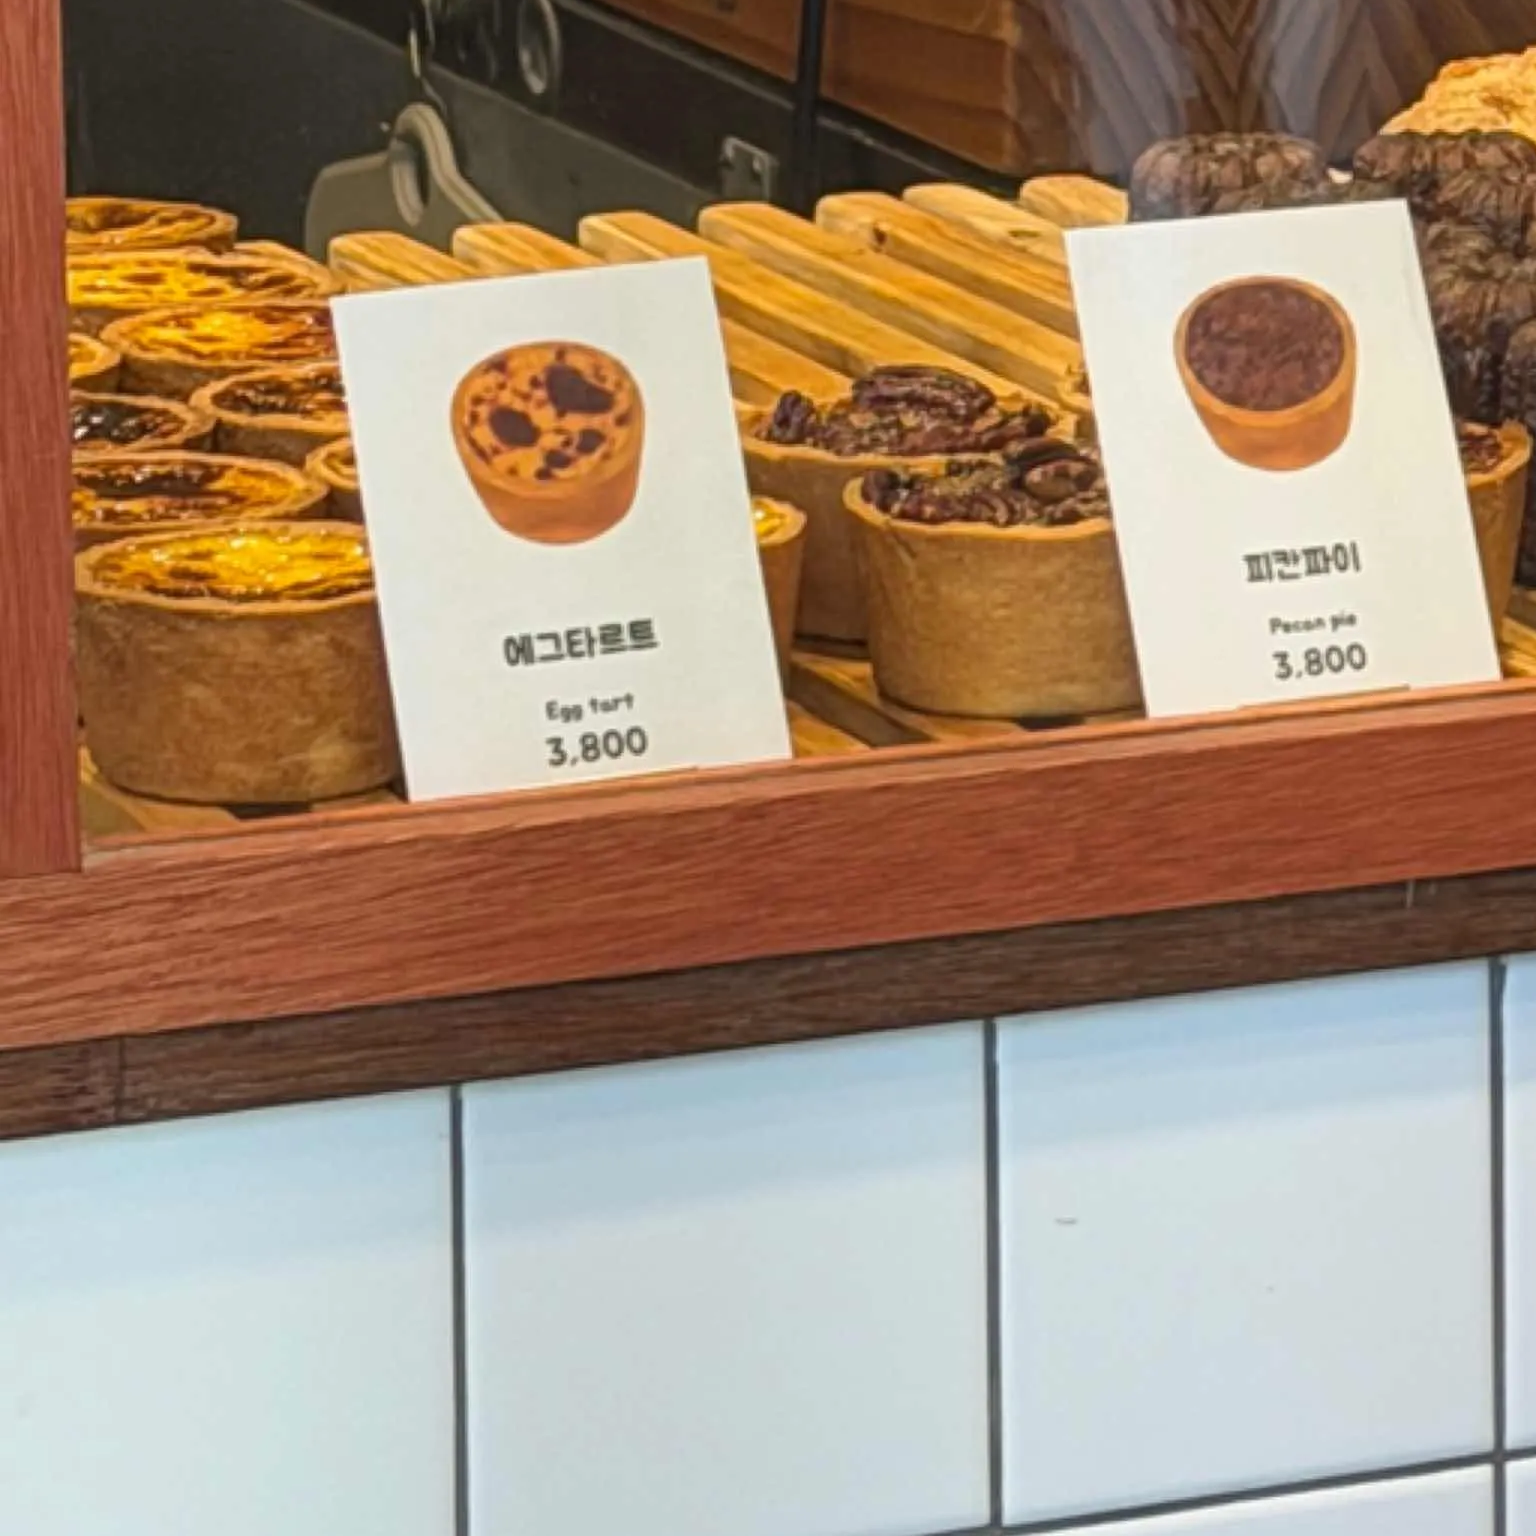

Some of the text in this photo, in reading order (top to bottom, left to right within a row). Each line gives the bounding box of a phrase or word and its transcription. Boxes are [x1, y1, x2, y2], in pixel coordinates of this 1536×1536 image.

[1242, 540, 1361, 583] 피칸파이
[504, 618, 660, 667] 에그타르트
[1269, 611, 1357, 635] Pecan pie
[1272, 642, 1367, 681] 3,800
[546, 692, 634, 724] Egg tart
[545, 726, 648, 768] 3,800
